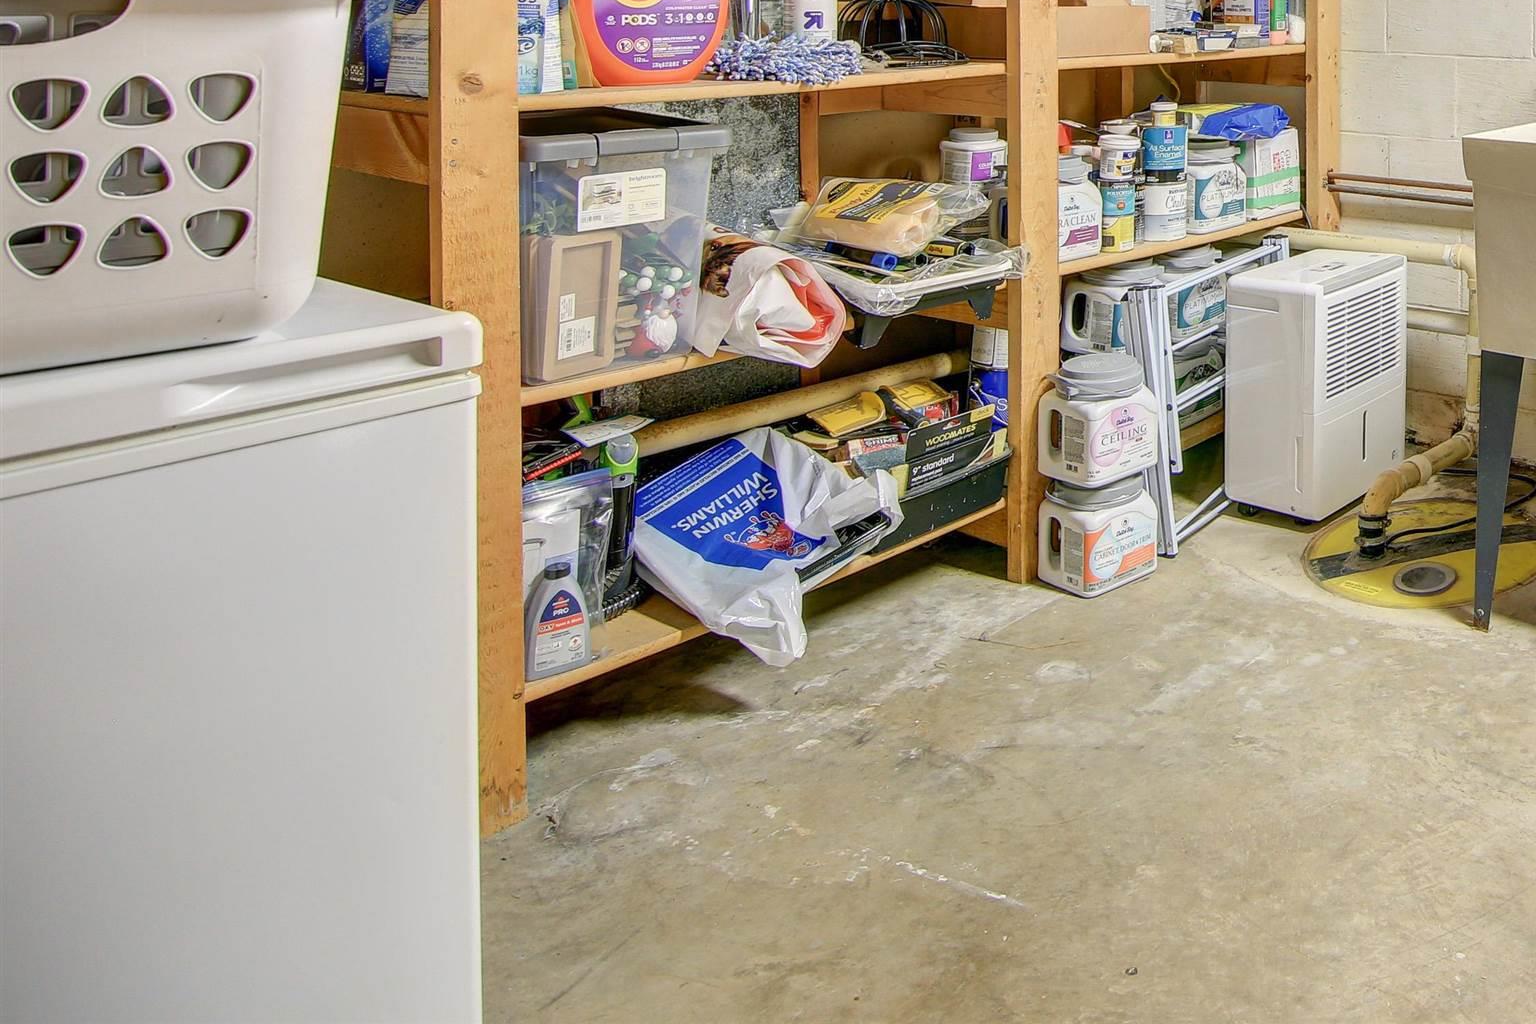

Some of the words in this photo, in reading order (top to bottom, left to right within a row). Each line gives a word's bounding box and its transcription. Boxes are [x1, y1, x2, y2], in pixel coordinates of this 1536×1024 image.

[621, 13, 657, 26] PODS
[1070, 212, 1097, 226] CLEAN
[925, 423, 978, 447] WOODMATES
[1101, 423, 1147, 446] CEILING
[922, 453, 955, 473] standard
[692, 481, 778, 539] SHERWIN
[552, 607, 570, 616] PRO
